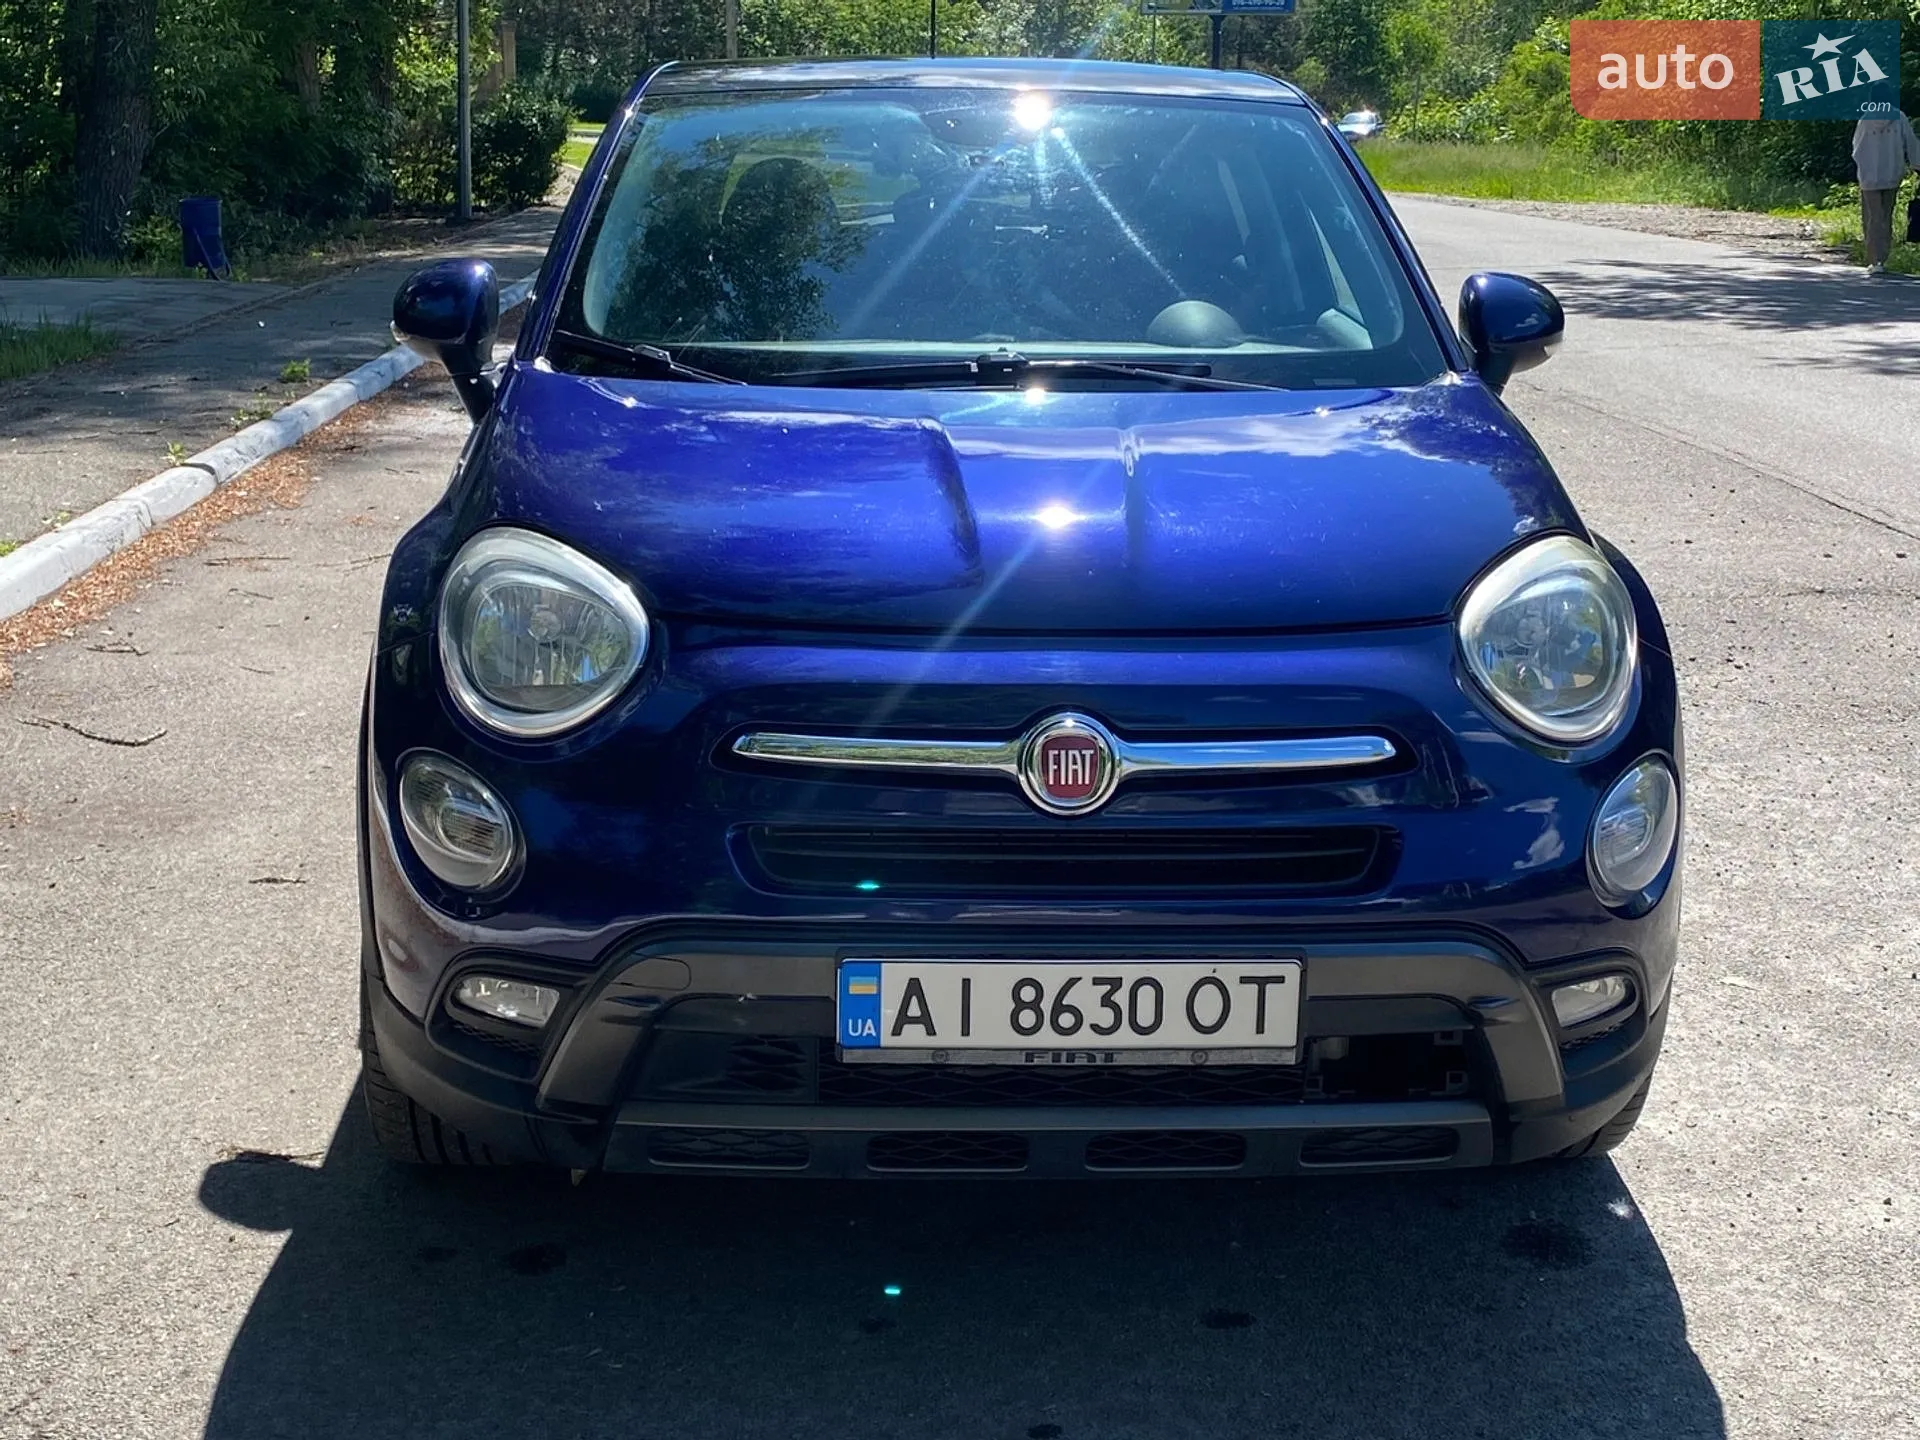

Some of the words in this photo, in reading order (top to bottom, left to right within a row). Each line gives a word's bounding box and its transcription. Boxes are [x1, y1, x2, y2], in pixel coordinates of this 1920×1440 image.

[1047, 749, 1095, 786] FIAT
[891, 977, 972, 1037] AI
[1009, 976, 1165, 1037] 8630
[1184, 974, 1287, 1036] OT
[848, 1018, 877, 1037] UA
[1024, 1050, 1123, 1064] FIAT
